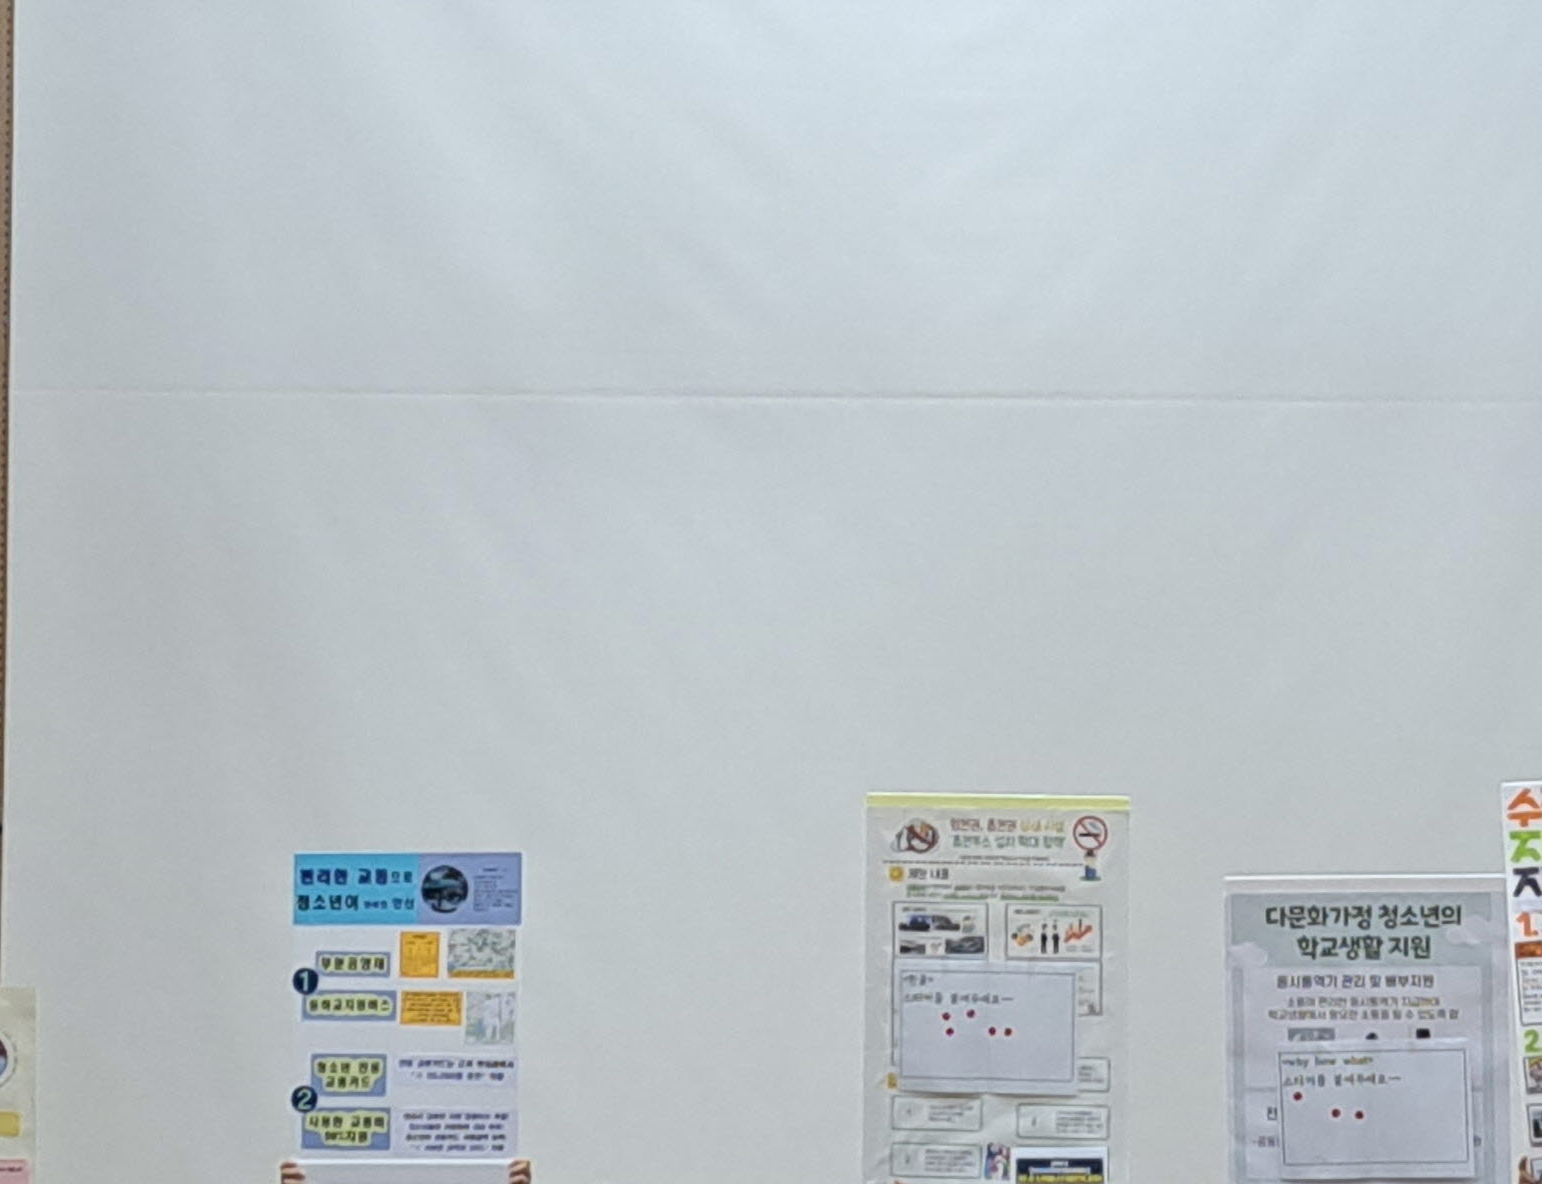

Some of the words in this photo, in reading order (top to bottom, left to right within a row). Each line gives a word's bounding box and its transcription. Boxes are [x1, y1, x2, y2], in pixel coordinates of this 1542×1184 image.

[1265, 905, 1373, 930] 다문화가정
[1379, 905, 1462, 929] 청소년의
[1297, 935, 1383, 960] 학교생활
[1388, 935, 1431, 960] 지원
[297, 1089, 312, 1110] 2
